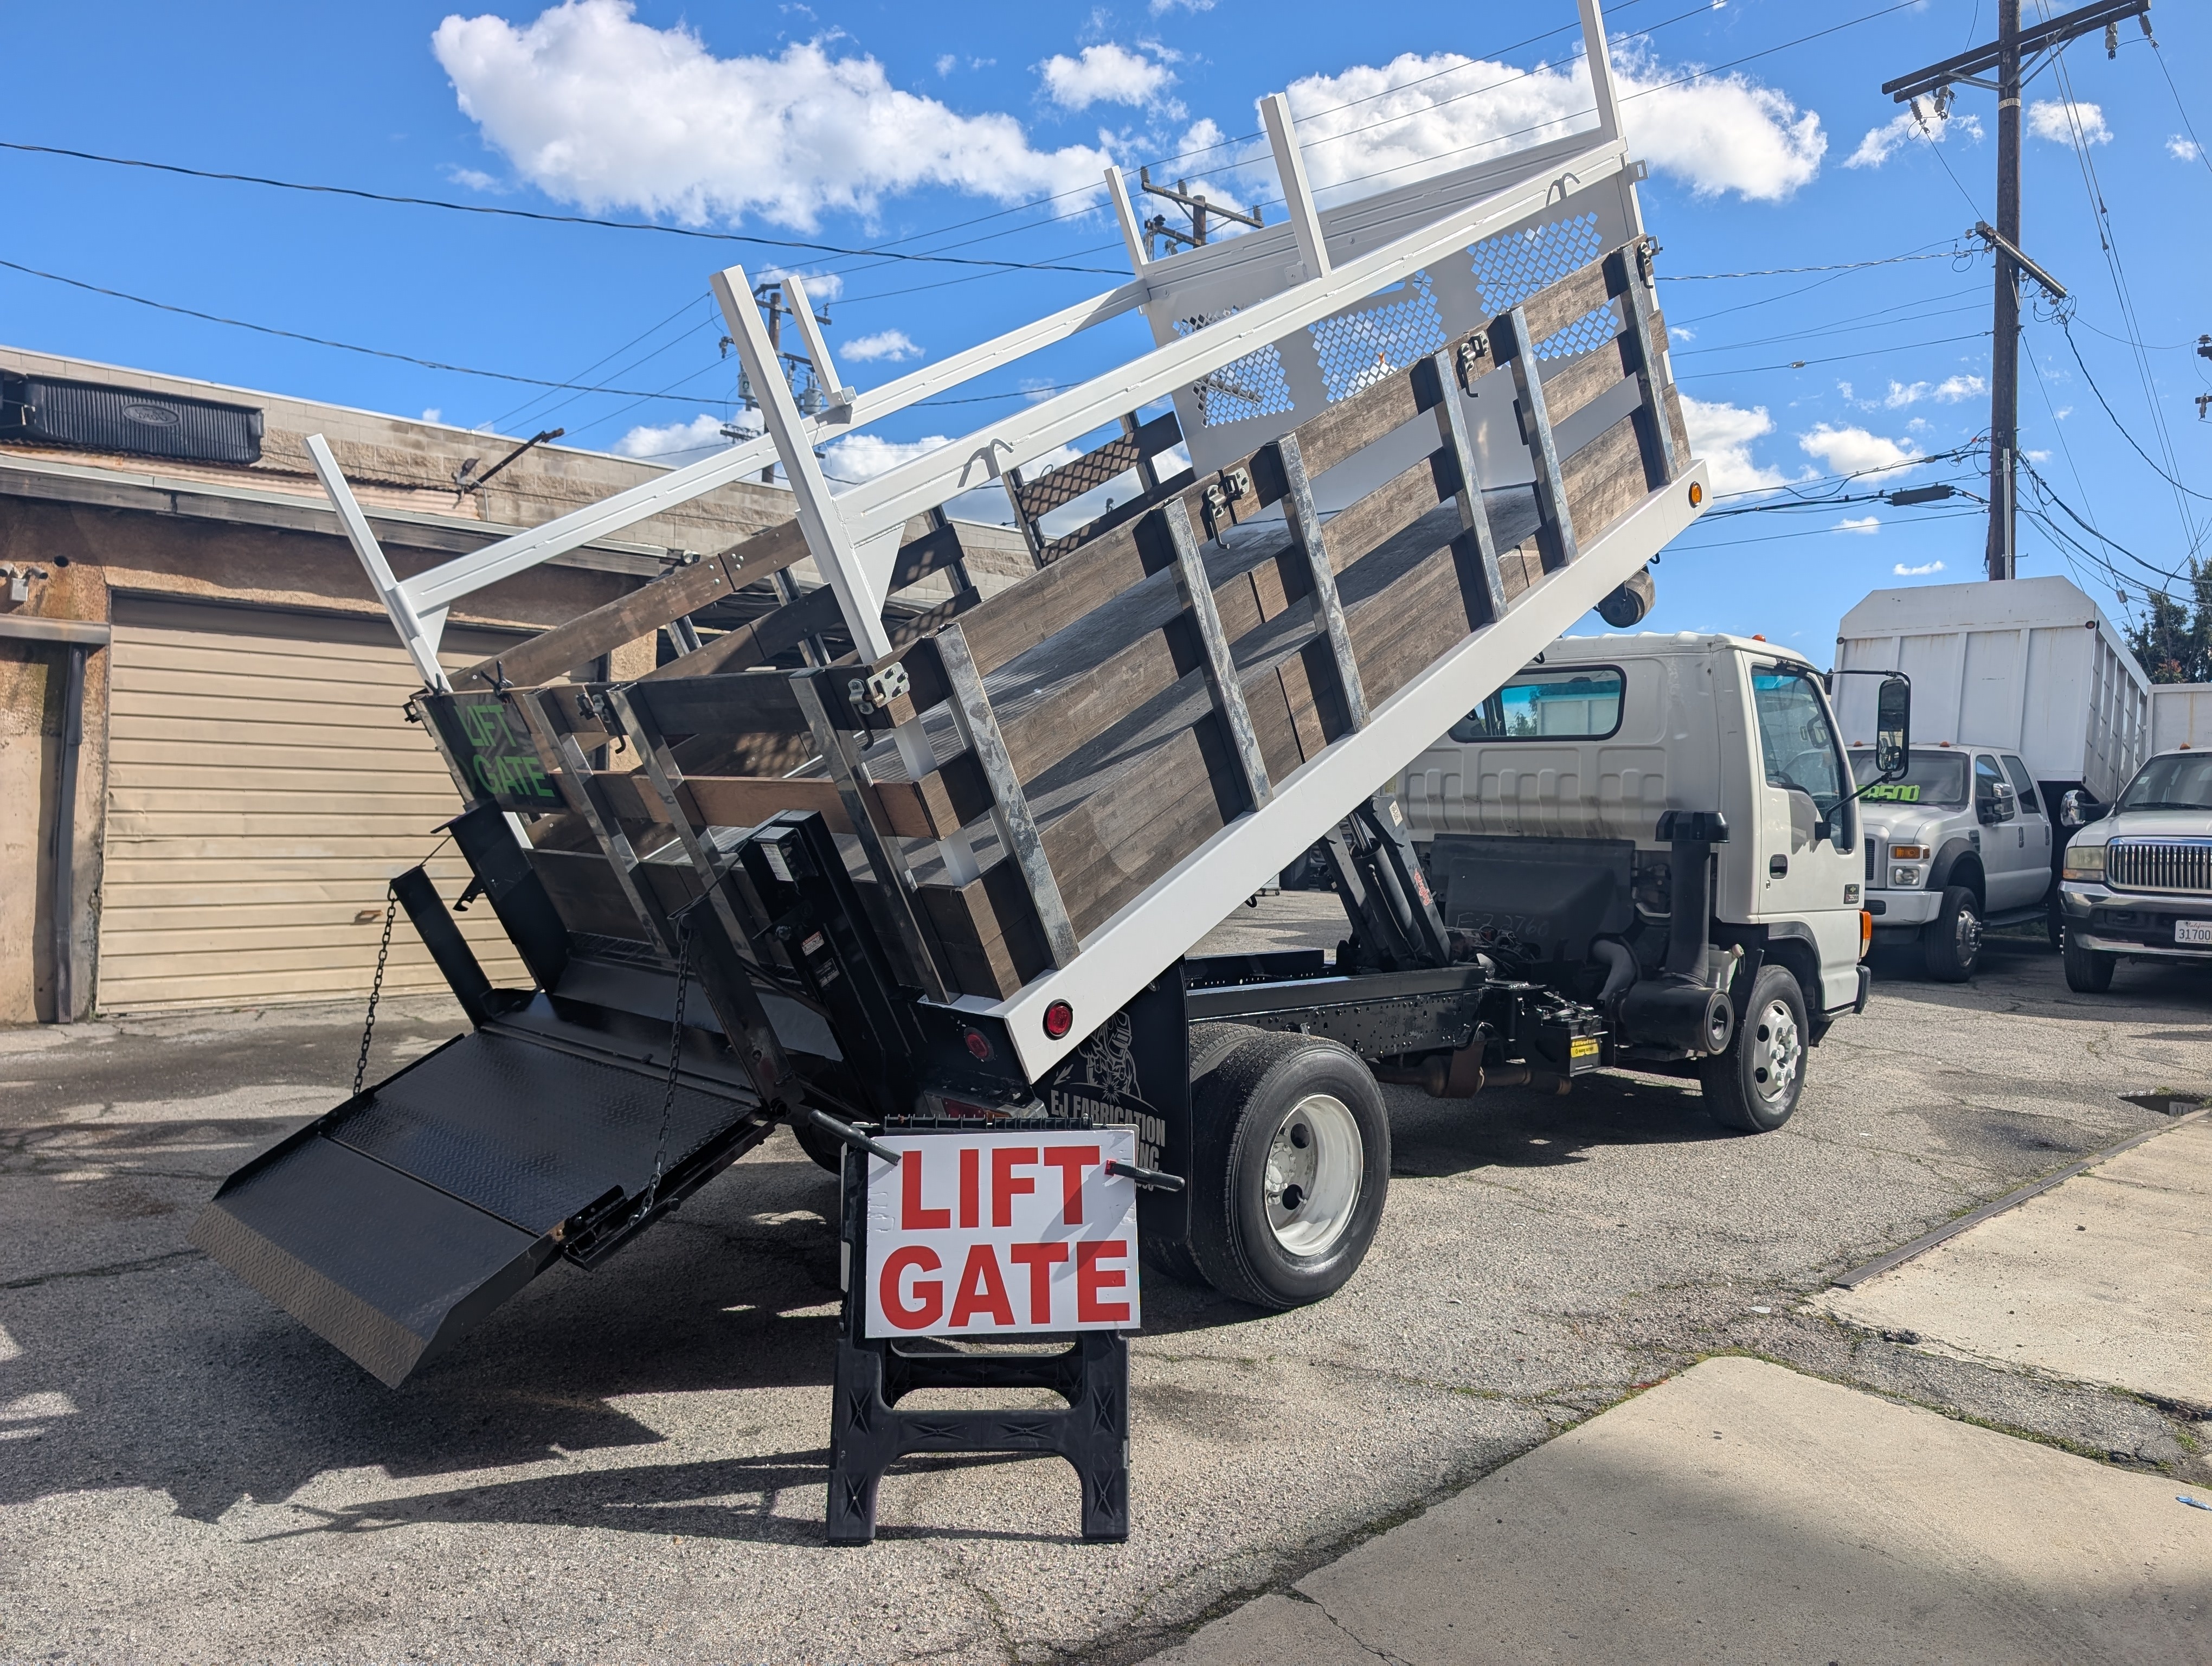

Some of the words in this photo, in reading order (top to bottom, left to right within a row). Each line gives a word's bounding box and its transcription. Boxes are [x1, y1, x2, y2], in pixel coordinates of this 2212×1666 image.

[453, 704, 517, 747] LIFT
[473, 754, 555, 798] GATE
[2178, 928, 2212, 941] 31700
[1051, 1089, 1069, 1118] EJ
[902, 1145, 1100, 1230] LIFT
[879, 1240, 1130, 1330] GATE
